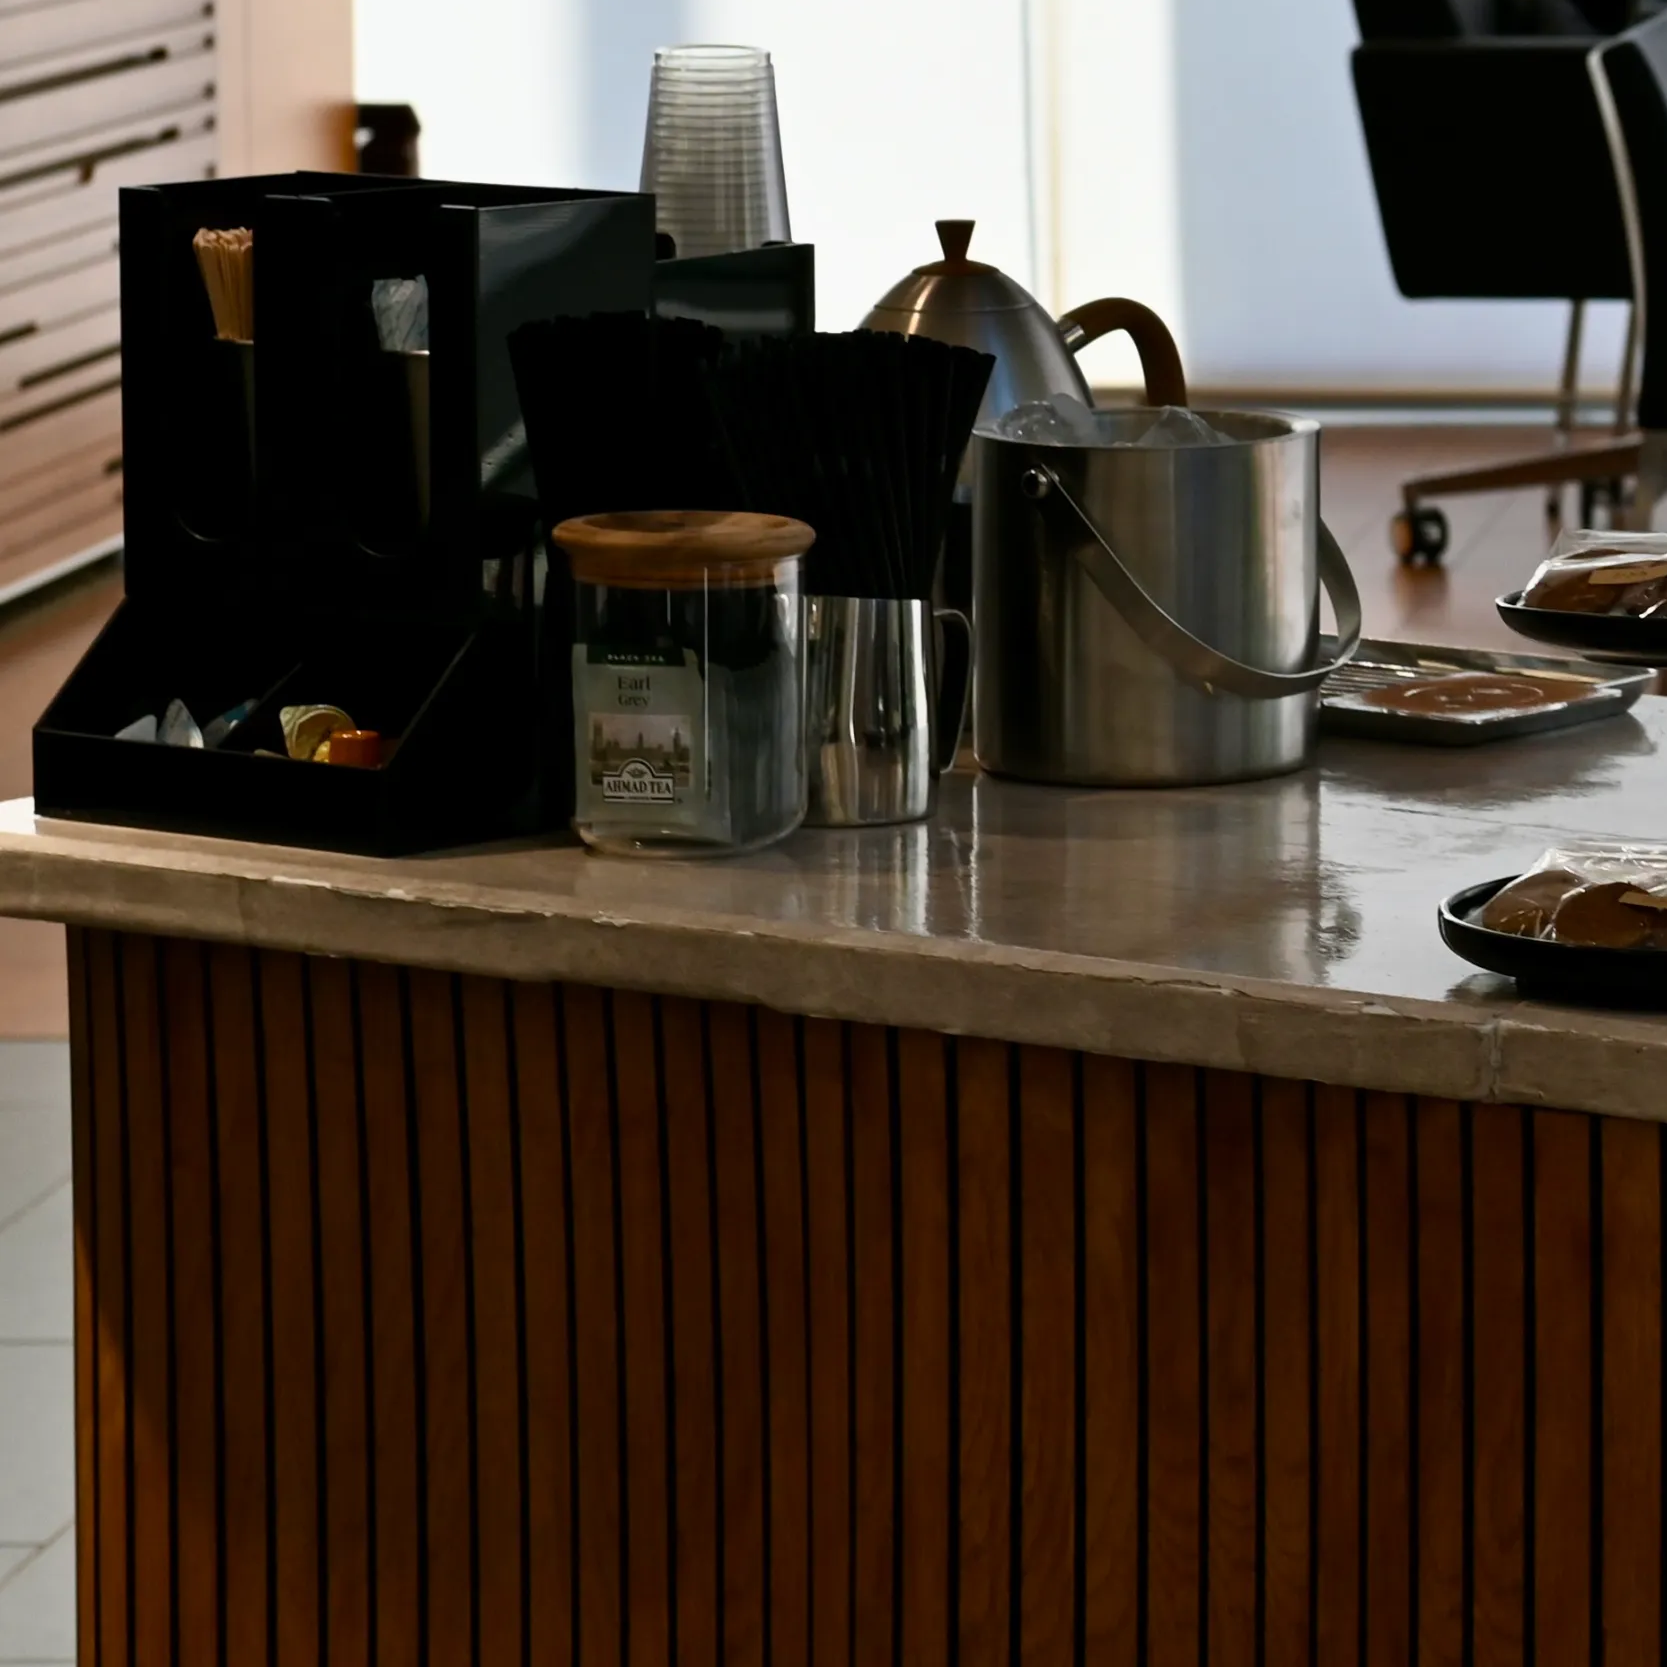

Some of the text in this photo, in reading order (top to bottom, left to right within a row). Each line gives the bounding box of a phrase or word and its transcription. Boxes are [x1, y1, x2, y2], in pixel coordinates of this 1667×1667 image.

[617, 676, 652, 692] Earl
[617, 694, 652, 708] Grey
[605, 780, 673, 795] AHMAD TEA
